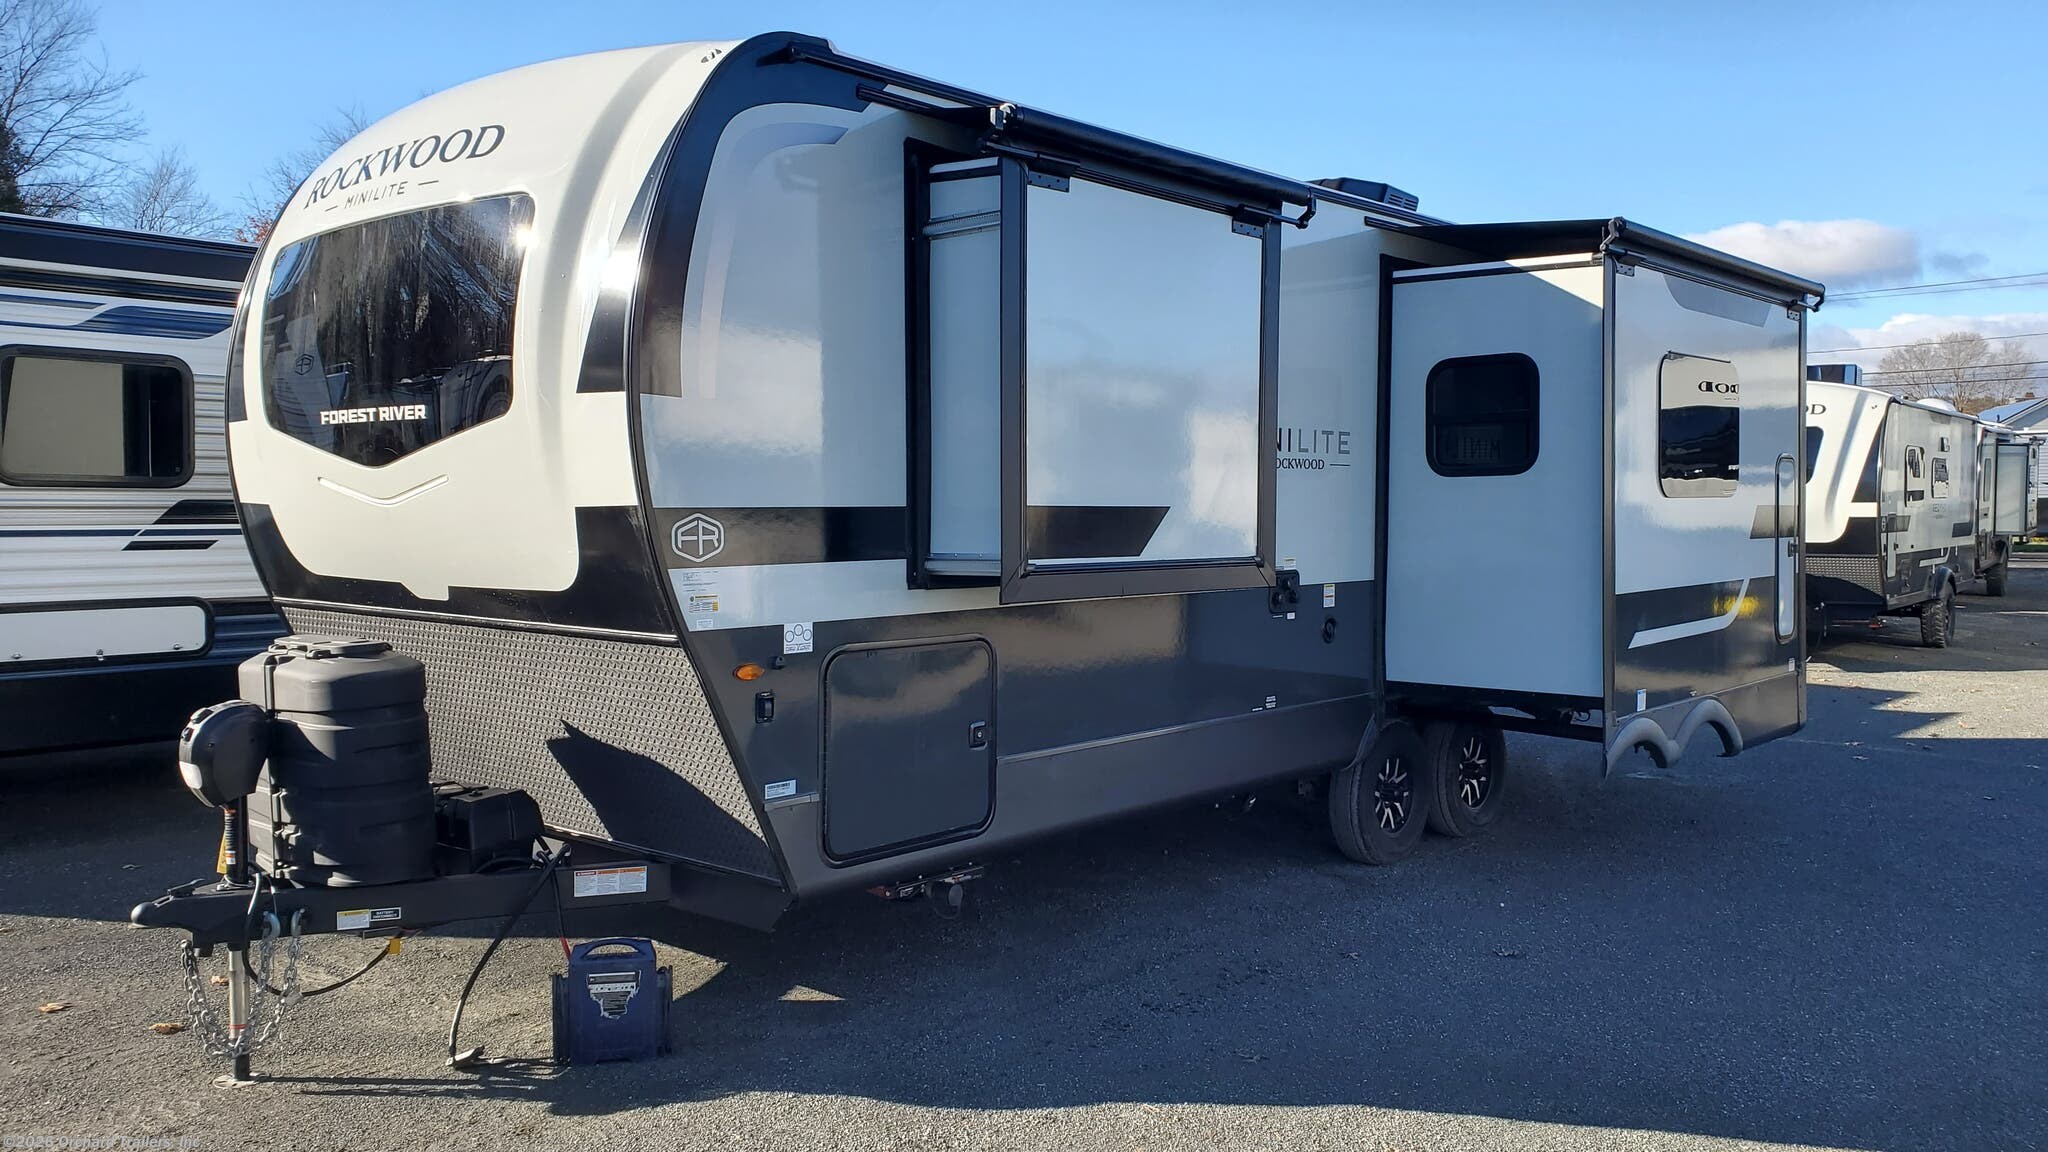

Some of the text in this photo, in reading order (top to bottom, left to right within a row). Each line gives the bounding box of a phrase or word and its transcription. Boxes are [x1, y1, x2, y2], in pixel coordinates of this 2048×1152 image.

[304, 124, 505, 209] ROCKWOOD
[344, 180, 409, 209] MINILITE
[320, 404, 427, 425] FOREST RIVER
